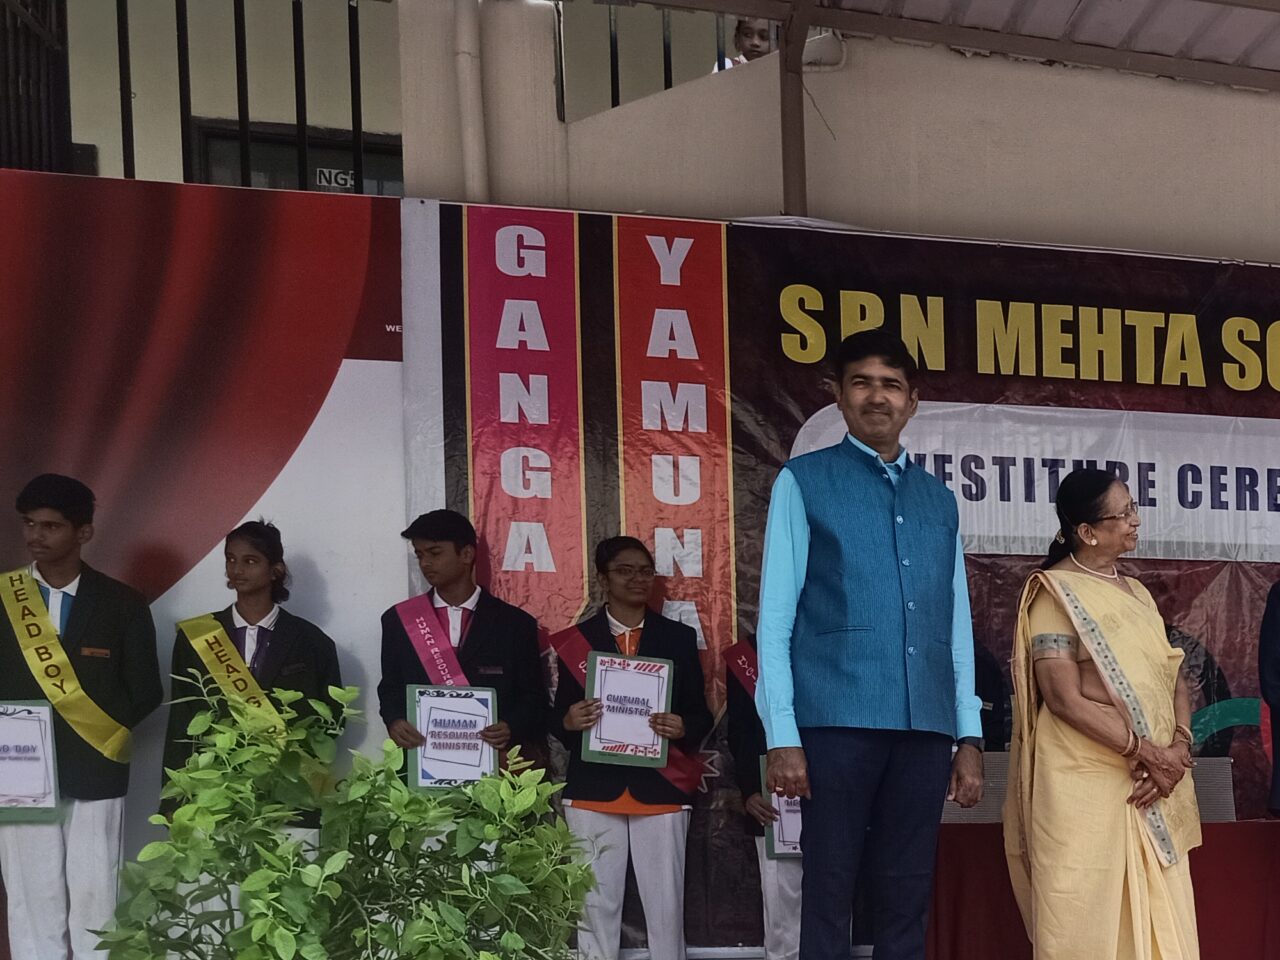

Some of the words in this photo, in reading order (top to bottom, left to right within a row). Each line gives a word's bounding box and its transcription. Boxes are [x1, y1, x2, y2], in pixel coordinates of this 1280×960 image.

[976, 299, 1207, 388] MEHTA
[494, 224, 557, 573] GANGA
[640, 234, 708, 651] YAMUNA
[8, 573, 43, 640] HEAD
[34, 644, 67, 696] BOY
[203, 634, 251, 693] HEAD
[415, 615, 436, 647] HUMAN
[430, 646, 457, 687] RESOURC
[430, 718, 478, 729] HUMAN
[604, 705, 653, 717] MINISTER
[606, 693, 653, 709] CULTURAL
[428, 730, 481, 740] RESOURCE
[430, 741, 480, 751] MINISTER
